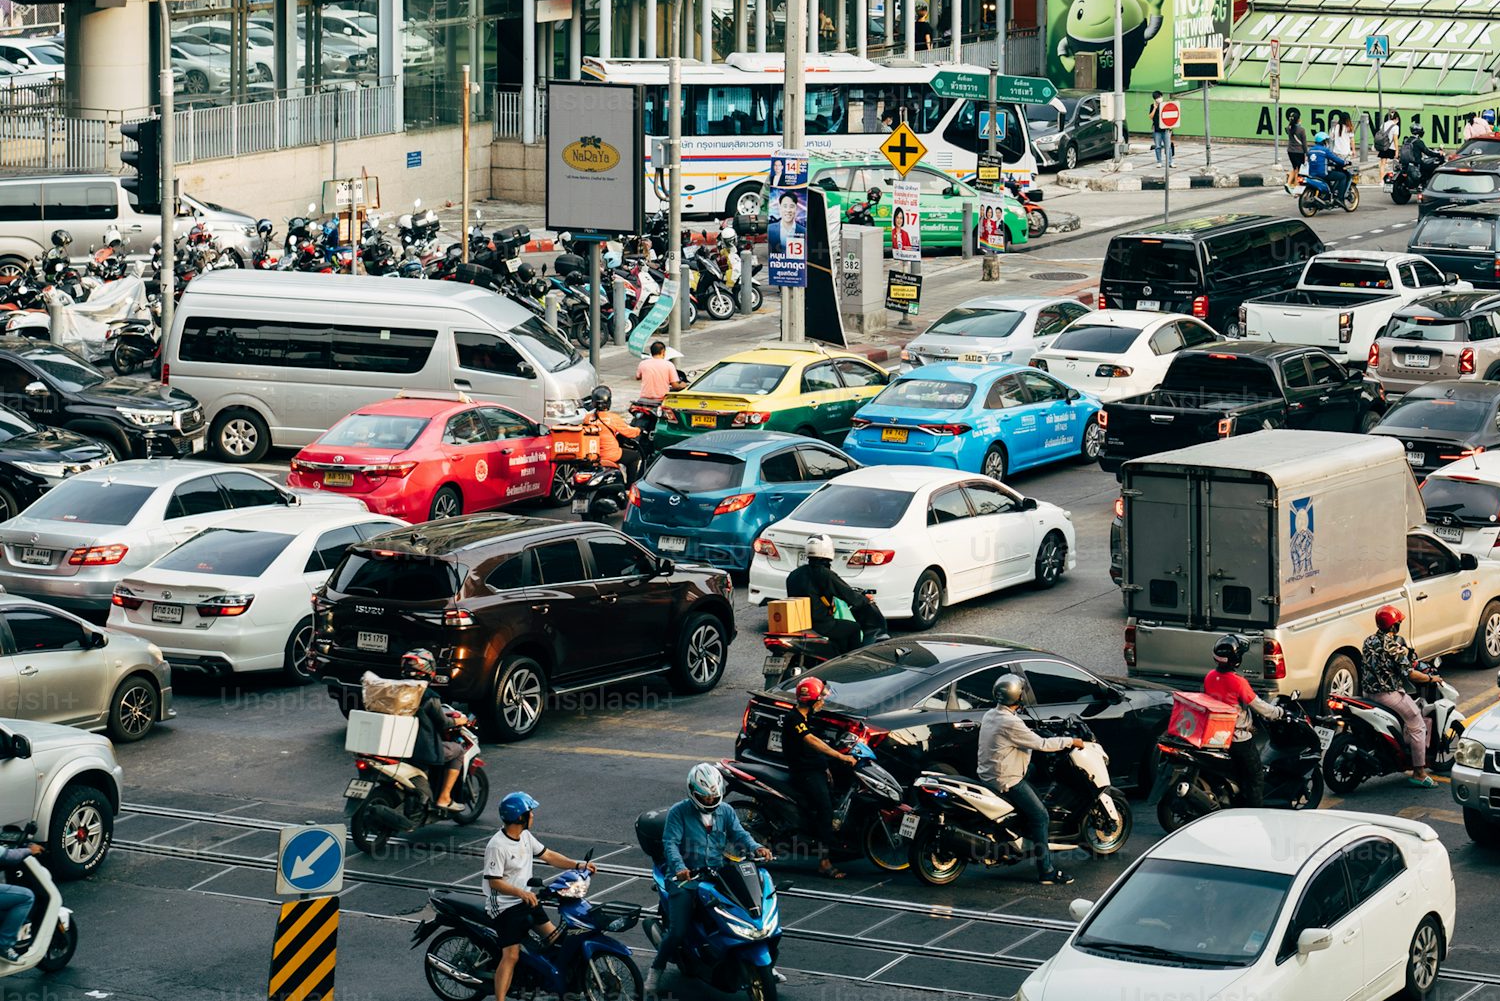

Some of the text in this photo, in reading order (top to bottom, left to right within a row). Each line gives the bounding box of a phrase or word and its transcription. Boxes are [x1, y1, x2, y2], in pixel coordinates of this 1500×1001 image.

[572, 149, 610, 163] NaRaYa
[786, 160, 796, 171] 14
[905, 212, 918, 226] 17
[788, 242, 803, 255] 13
[670, 252, 675, 260] 8
[844, 260, 859, 270] 382
[162, 284, 167, 292] 7
[965, 354, 976, 362] TAXI
[355, 605, 384, 615] ISUZU
[373, 634, 387, 643] 1751
[795, 724, 808, 734] 12
